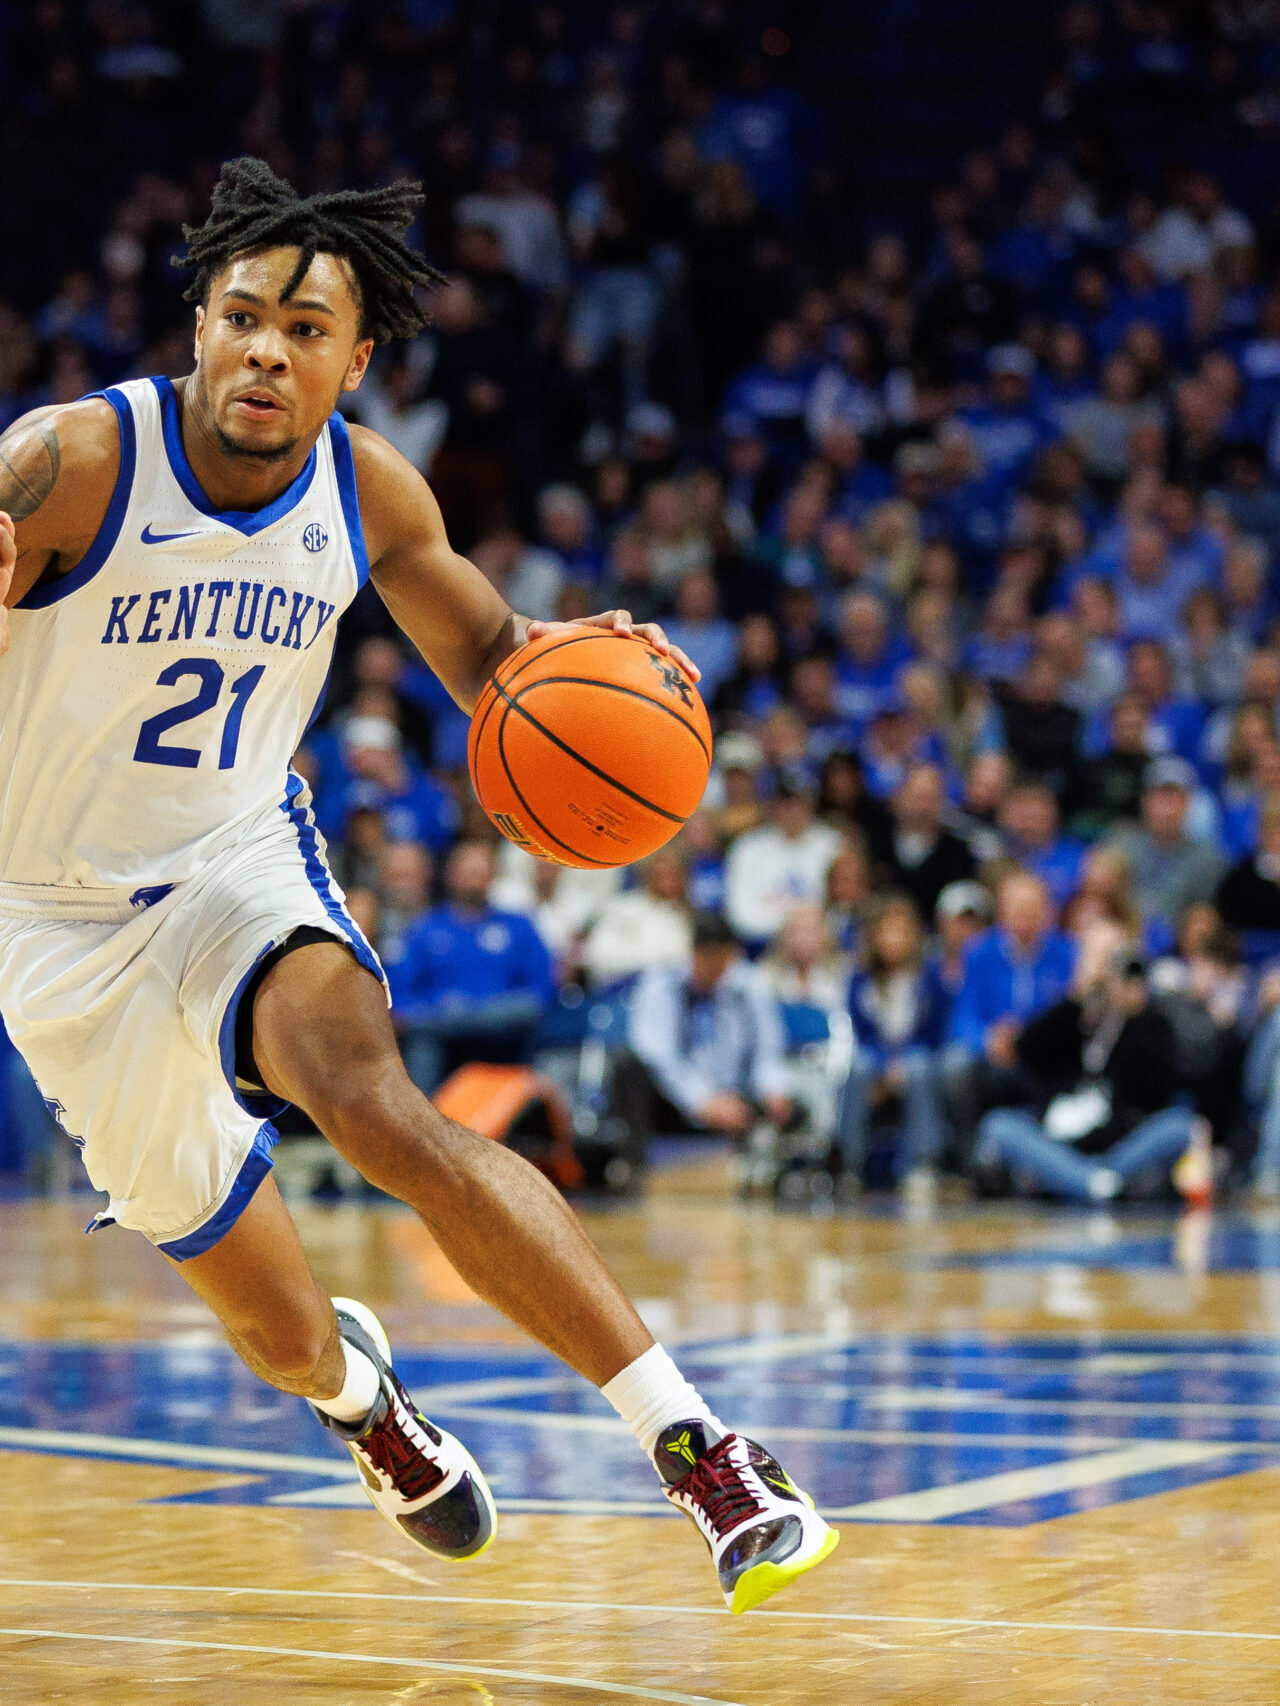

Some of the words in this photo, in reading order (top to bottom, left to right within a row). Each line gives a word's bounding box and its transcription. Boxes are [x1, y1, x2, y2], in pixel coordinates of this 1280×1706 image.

[304, 523, 328, 552] SEC
[101, 581, 336, 650] KENTUCKY
[133, 658, 267, 770] 21
